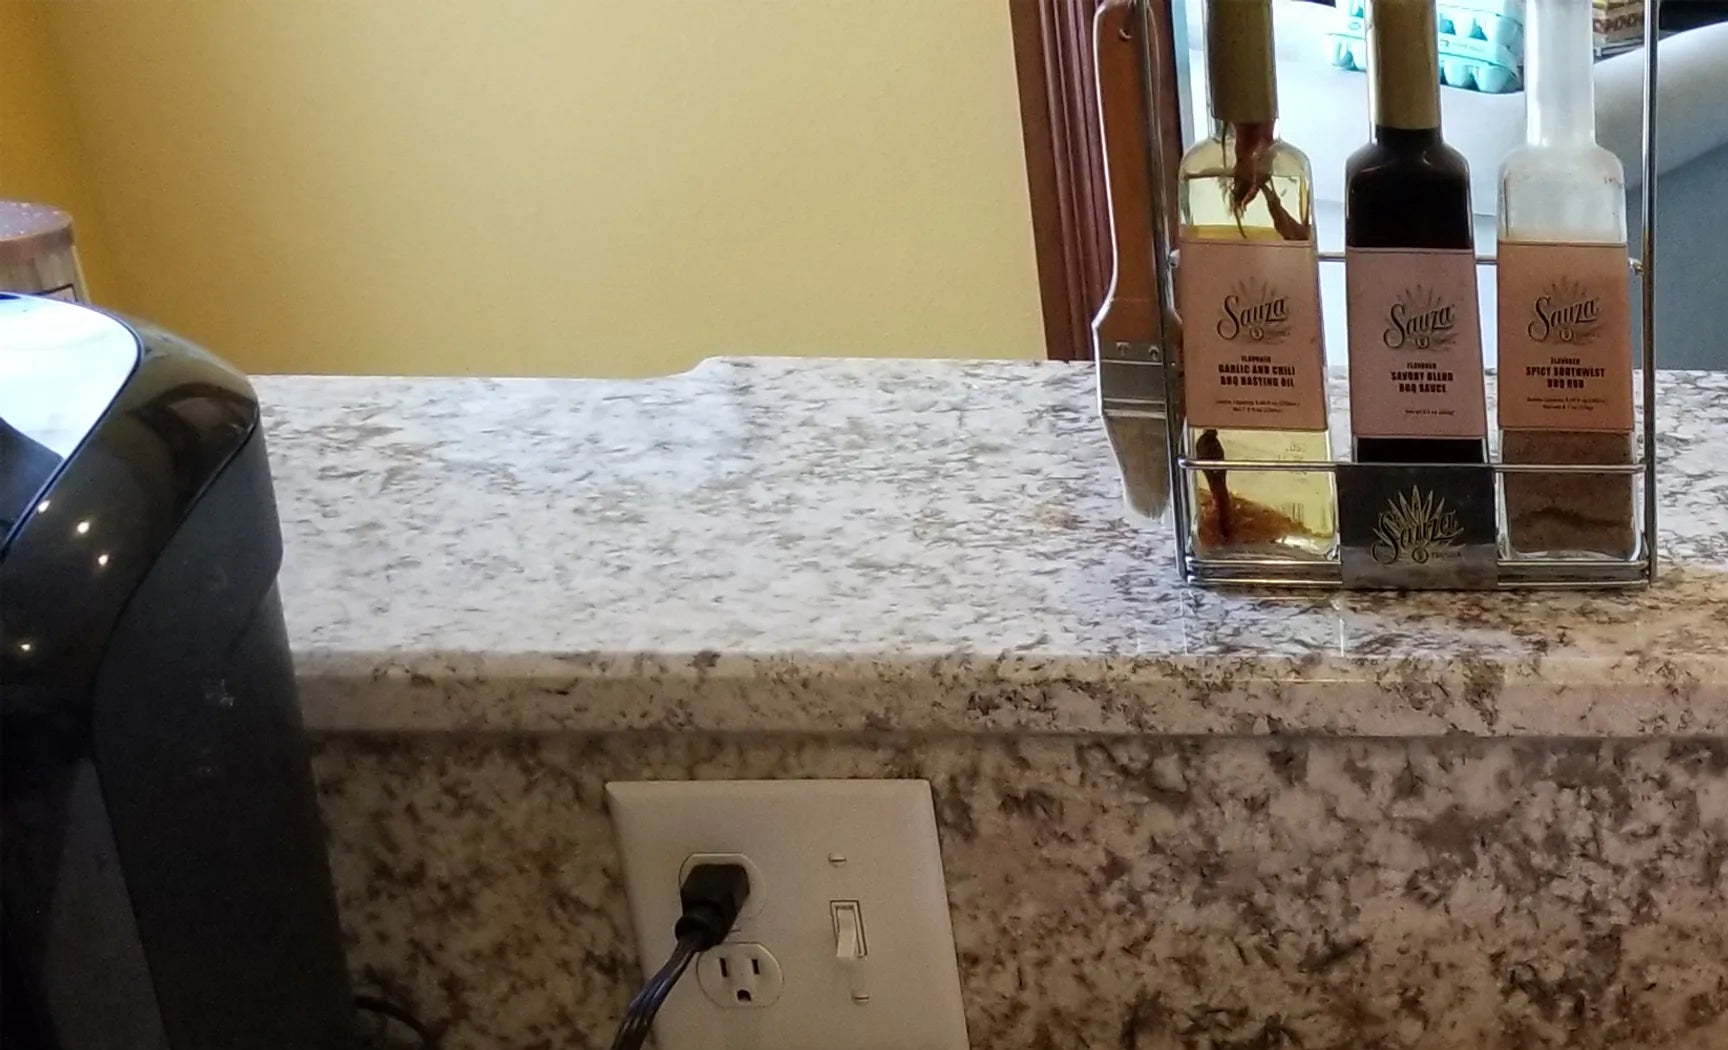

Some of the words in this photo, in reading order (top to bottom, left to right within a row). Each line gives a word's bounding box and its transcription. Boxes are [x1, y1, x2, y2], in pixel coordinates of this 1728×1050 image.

[1217, 295, 1288, 340] Sauza
[1528, 297, 1598, 342] Sauza
[1383, 304, 1454, 348] Sauza
[1218, 364, 1250, 374] GARLIC
[1252, 365, 1269, 375] AND
[1272, 366, 1295, 376] CHILI
[1391, 371, 1424, 381] SAVORY
[1427, 372, 1453, 381] BLEND
[1526, 366, 1551, 377] SPICY
[1553, 367, 1605, 378] SOUTHWEST
[1220, 375, 1238, 386] BBQ
[1240, 376, 1278, 387] BASTING
[1281, 377, 1295, 388] OIL
[1547, 378, 1565, 389] BBQ
[1567, 379, 1584, 389] RUB
[1399, 383, 1416, 393] BBQ
[1419, 384, 1447, 393] SAUCE
[1371, 511, 1464, 565] Sauza
